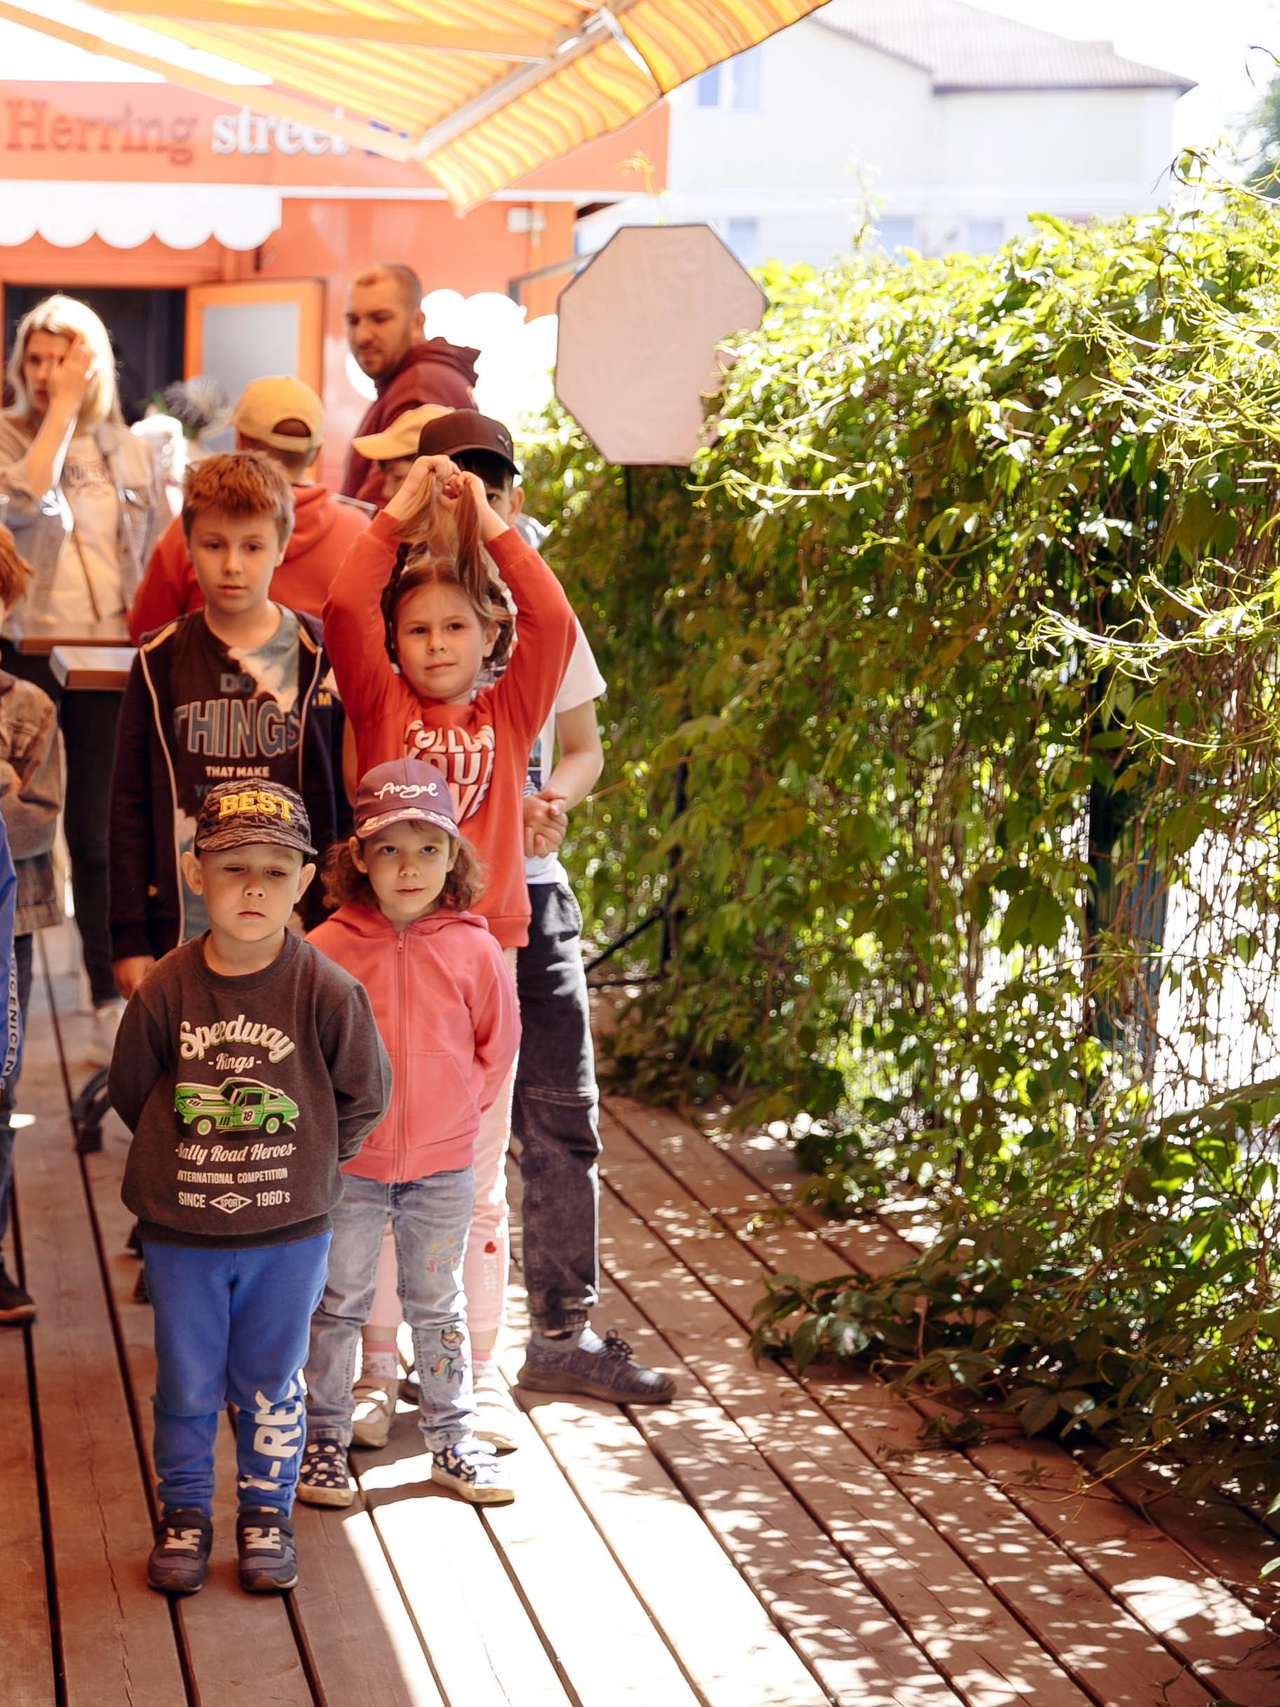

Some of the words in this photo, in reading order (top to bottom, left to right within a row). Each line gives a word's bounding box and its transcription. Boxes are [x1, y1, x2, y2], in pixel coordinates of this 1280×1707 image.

[4, 100, 197, 166] Herring
[220, 673, 255, 693] DO
[173, 698, 301, 758] THINGS
[205, 766, 235, 778] THAT
[236, 766, 270, 778] MAKE
[374, 782, 439, 800] Angel
[219, 791, 294, 821] BEST
[180, 1014, 295, 1063] Speedway
[243, 1110, 253, 1121] 18
[209, 1145, 249, 1162] Road
[237, 1168, 289, 1184] COMPETITION
[178, 1192, 207, 1208] SINCE
[220, 1198, 242, 1208] SPORT
[256, 1190, 292, 1207] 1960's
